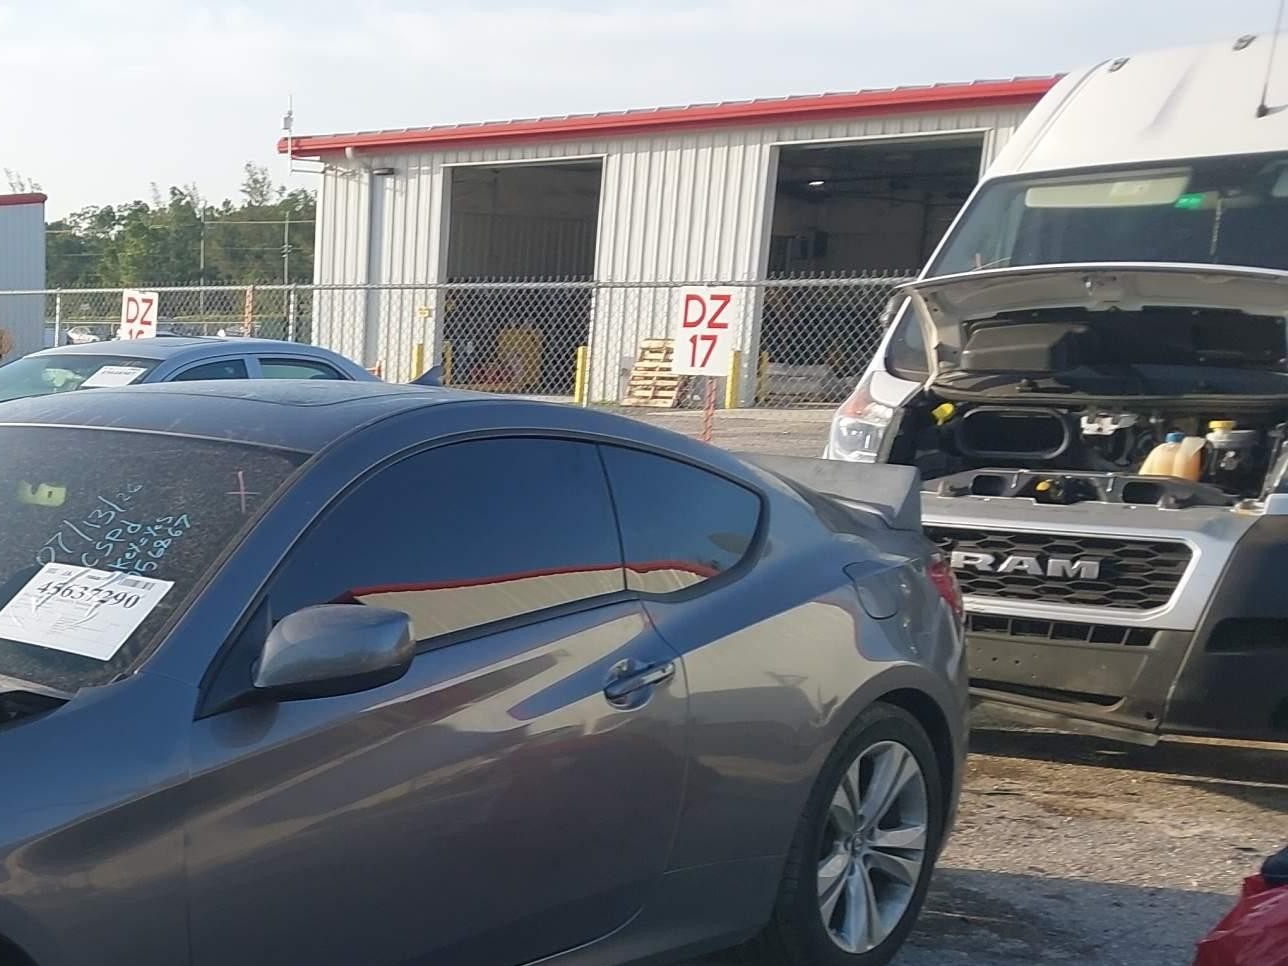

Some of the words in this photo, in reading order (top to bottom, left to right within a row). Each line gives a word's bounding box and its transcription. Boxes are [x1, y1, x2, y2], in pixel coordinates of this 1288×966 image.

[126, 296, 153, 326] DZ
[682, 294, 732, 329] DZ
[688, 334, 718, 368] 17
[950, 550, 1101, 580] RAM
[37, 580, 141, 609] 45637290
